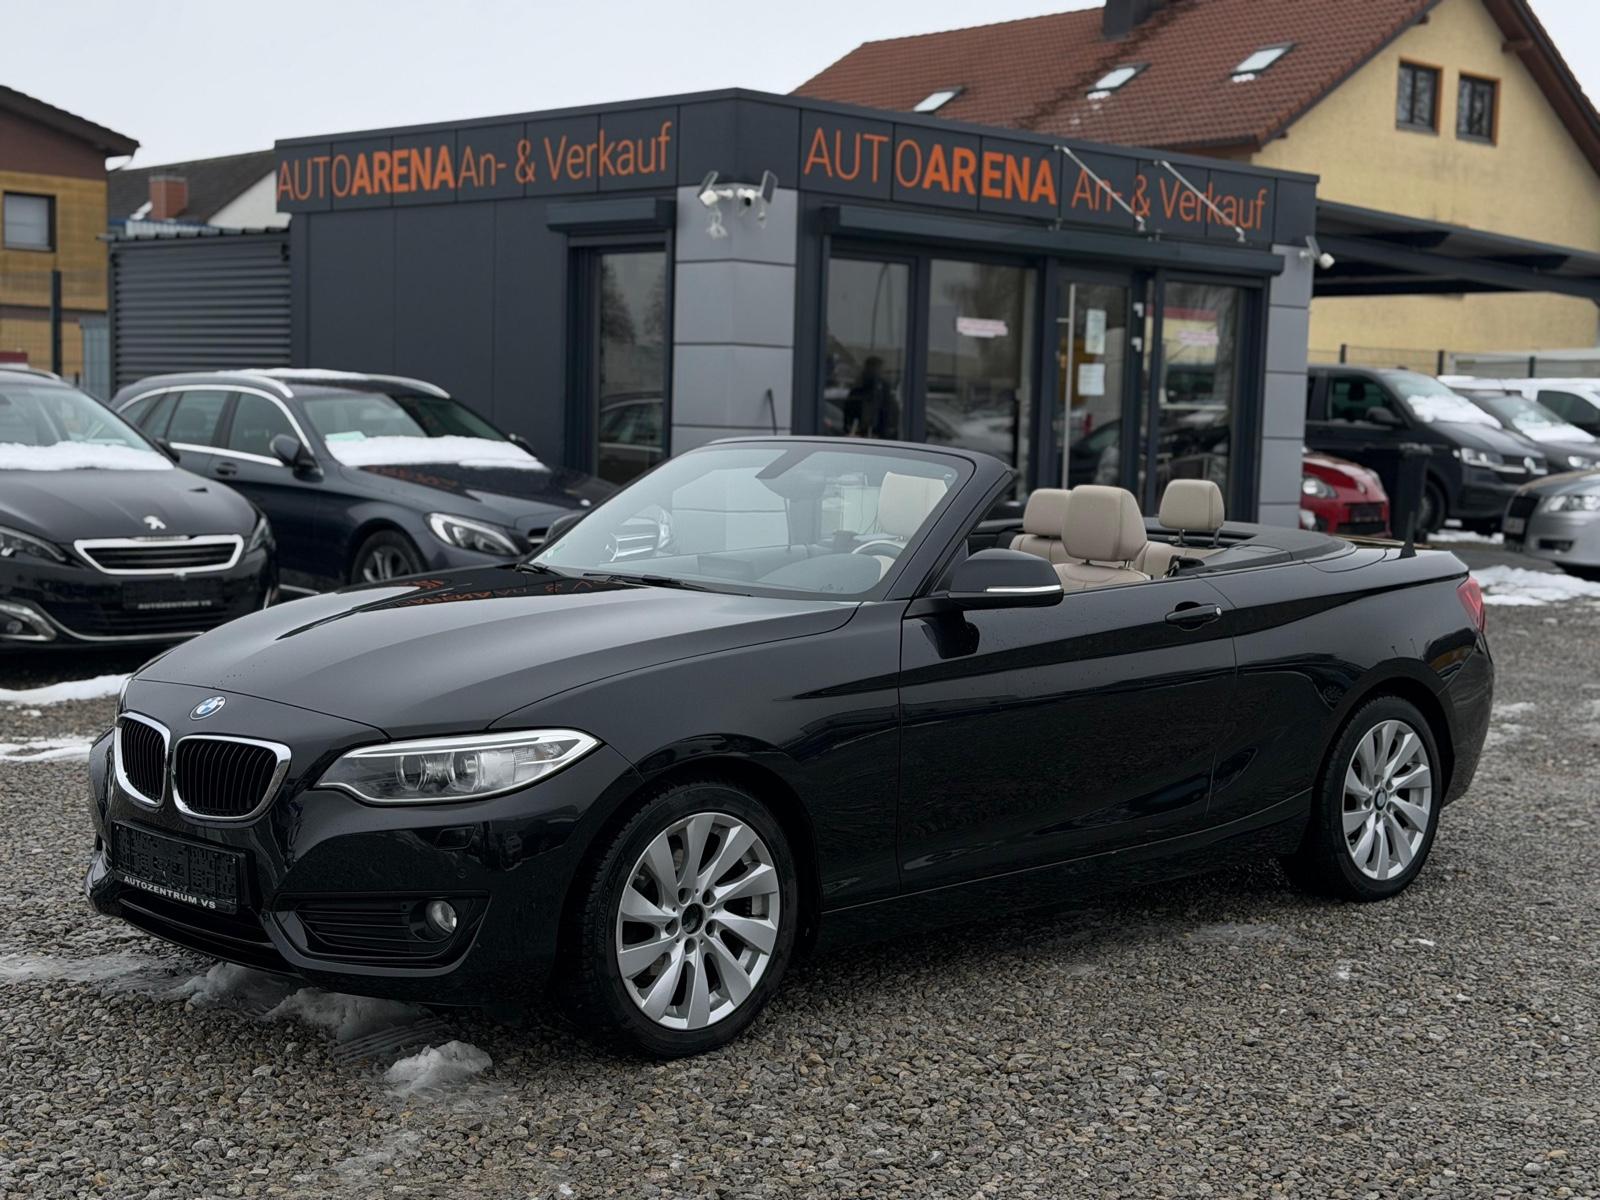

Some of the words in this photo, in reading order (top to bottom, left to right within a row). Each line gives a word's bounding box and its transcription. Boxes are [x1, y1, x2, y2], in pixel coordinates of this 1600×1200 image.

[277, 145, 456, 200] AUTOARENA
[458, 145, 506, 188] An-
[515, 139, 535, 184] &
[543, 122, 672, 181] Verkauf
[804, 127, 1057, 206] AUTOARENA
[1071, 167, 1123, 212] An-
[1131, 173, 1150, 217] &
[1159, 176, 1268, 230] Verkauf
[123, 875, 198, 905] AUTOZENTRUM
[200, 898, 217, 909] VS
